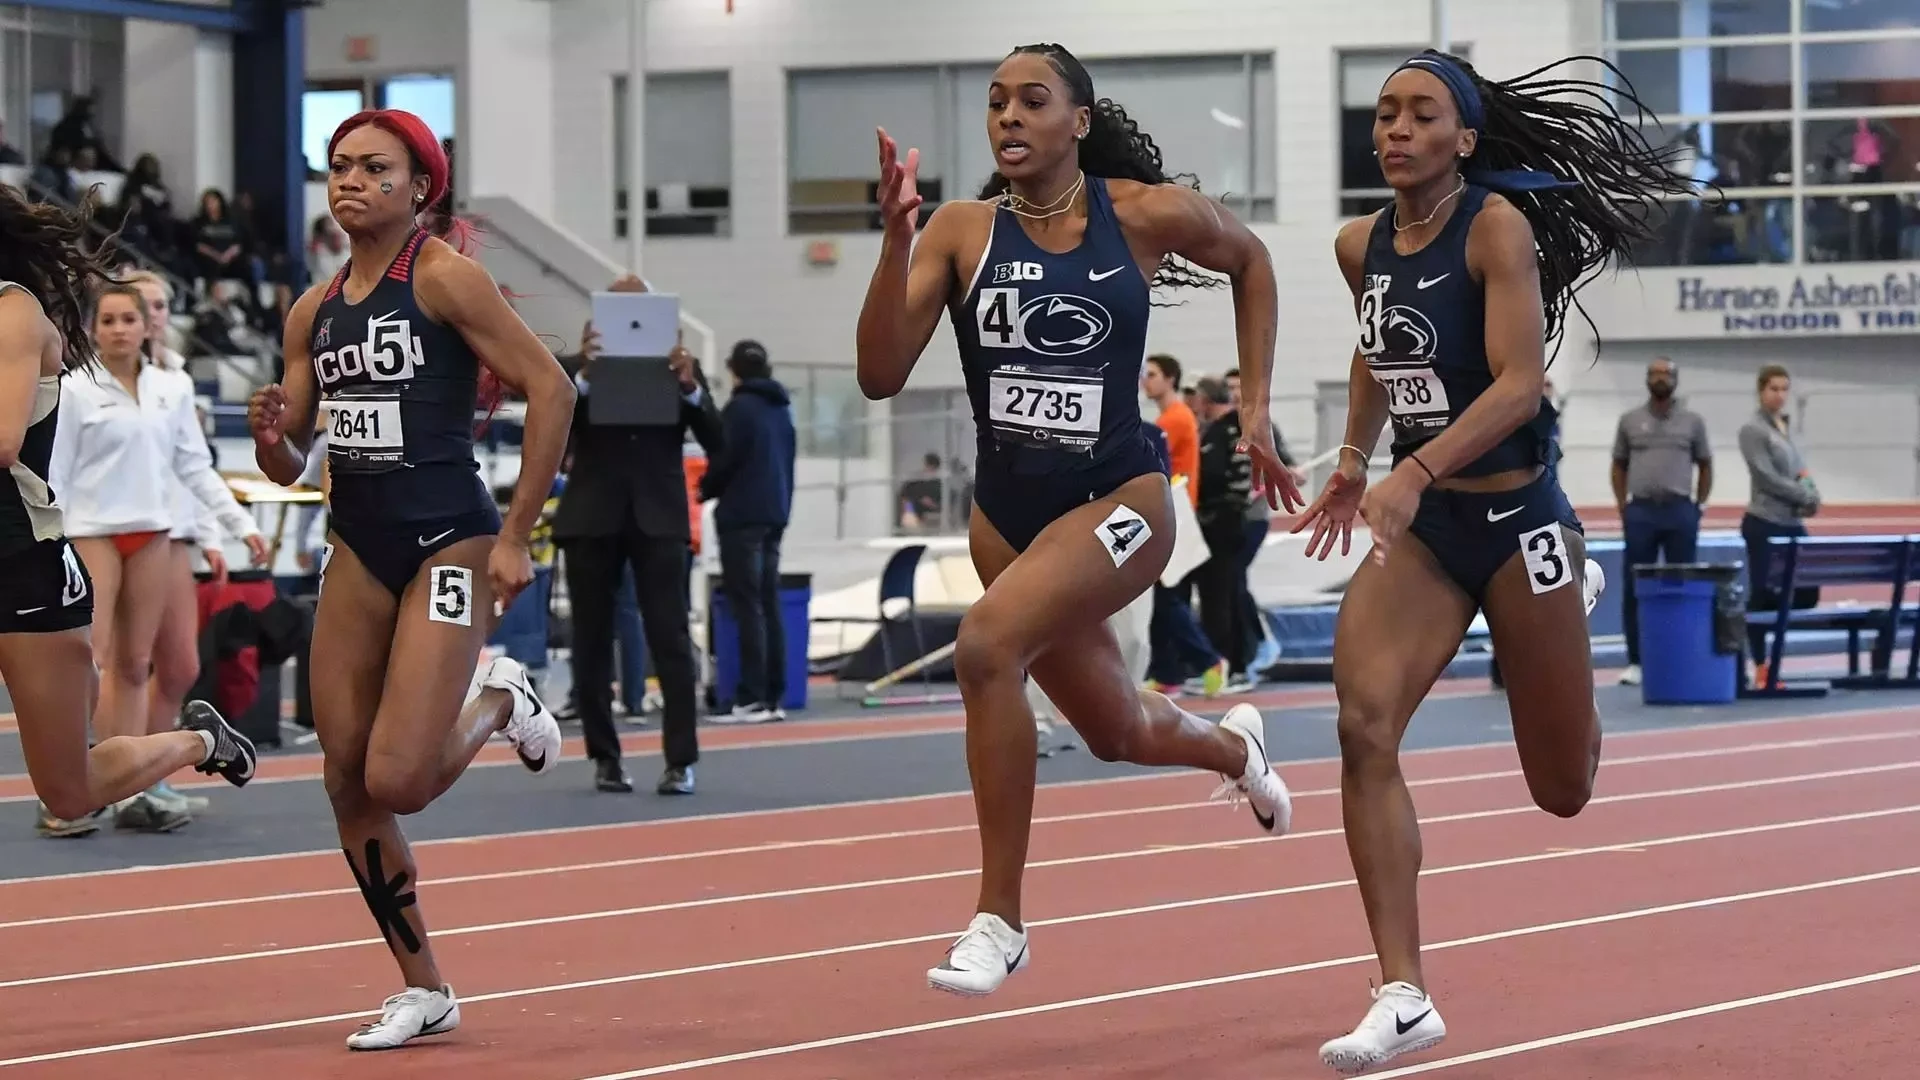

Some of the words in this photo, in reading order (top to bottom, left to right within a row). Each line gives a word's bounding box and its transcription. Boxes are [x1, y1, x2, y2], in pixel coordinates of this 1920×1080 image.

[1677, 277, 1780, 311] Horace
[1788, 272, 1920, 307] Ashenfel
[983, 292, 1013, 343] 4
[1361, 295, 1376, 349] 3
[1723, 312, 1840, 330] INDOOR
[1858, 310, 1920, 327] TRA
[373, 325, 405, 376] 5
[1005, 386, 1082, 423] 2735
[1379, 376, 1431, 406] 738
[330, 409, 380, 439] 2641
[1106, 518, 1145, 555] 4
[1527, 530, 1564, 586] 3
[435, 570, 467, 619] 5
